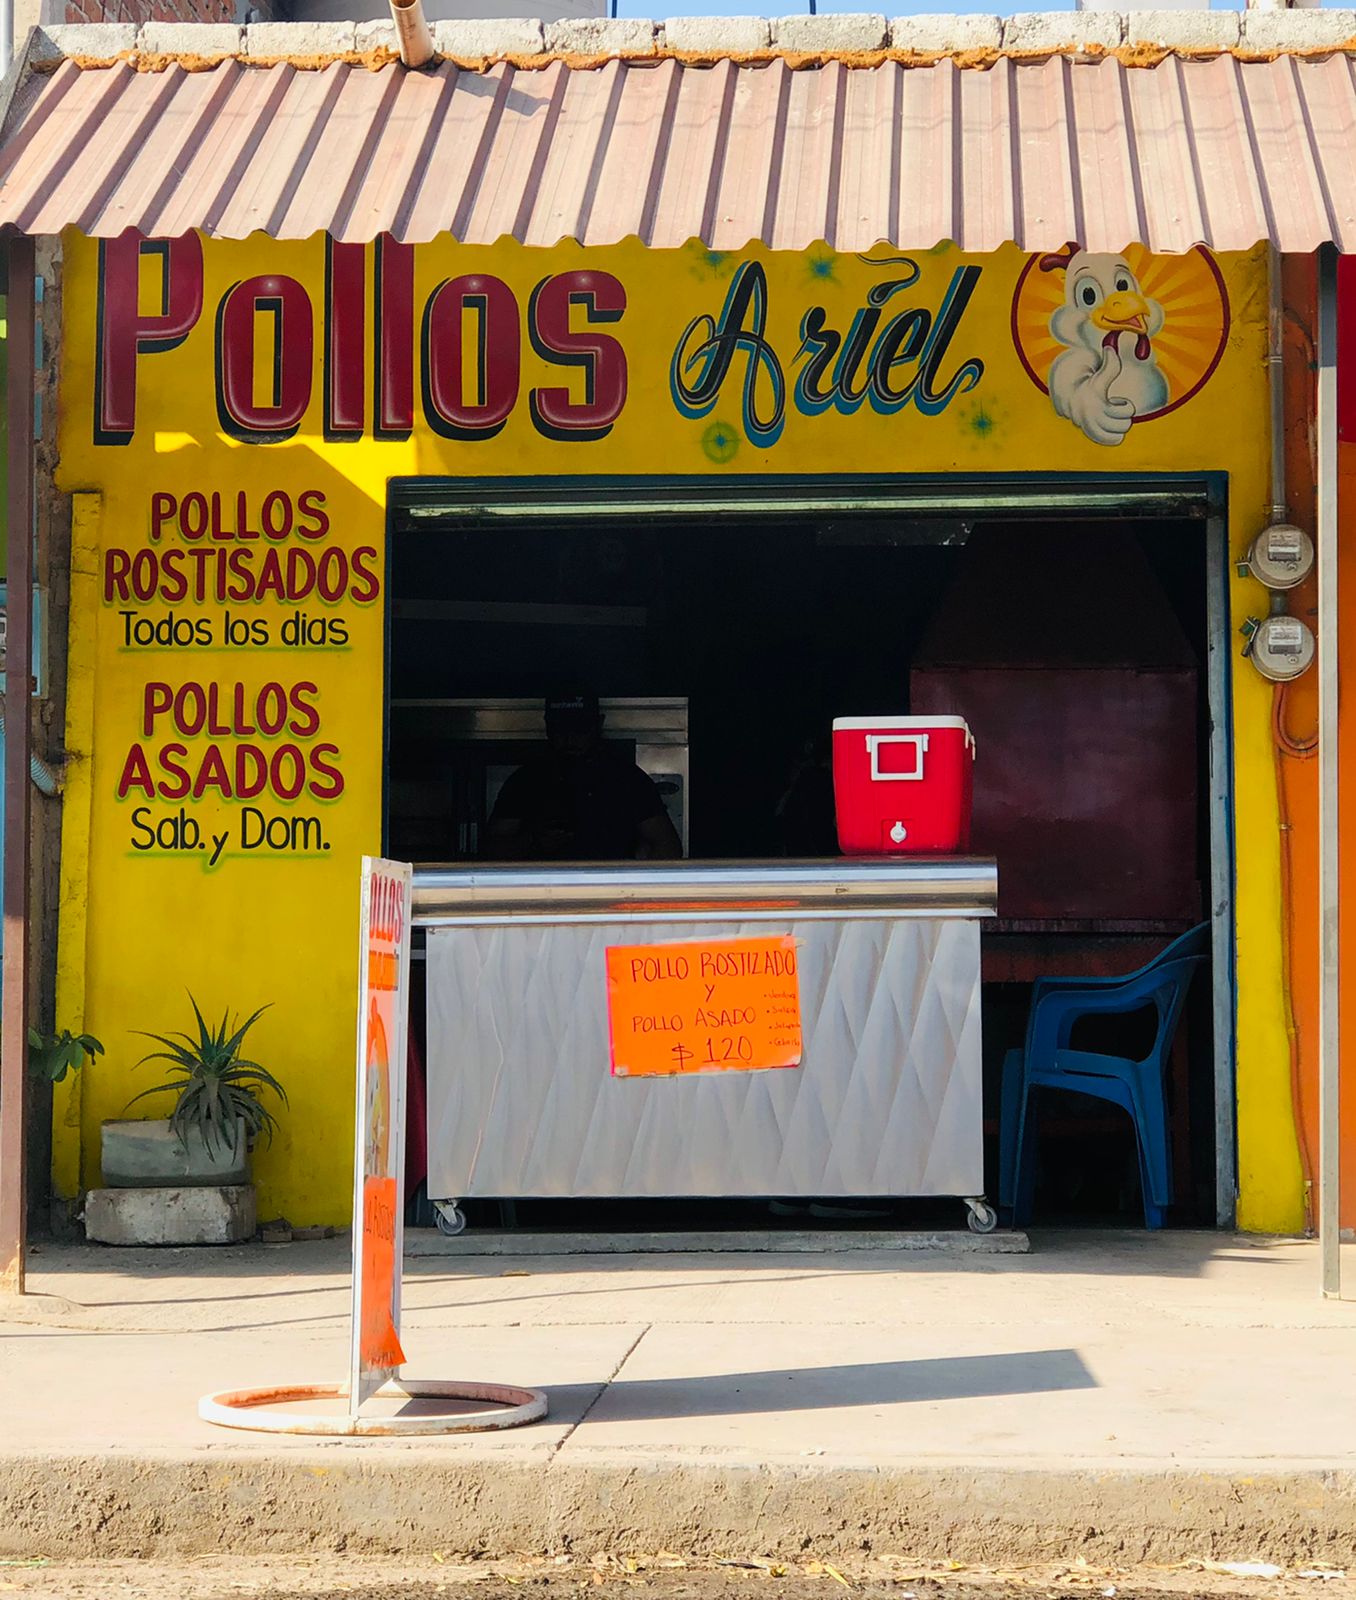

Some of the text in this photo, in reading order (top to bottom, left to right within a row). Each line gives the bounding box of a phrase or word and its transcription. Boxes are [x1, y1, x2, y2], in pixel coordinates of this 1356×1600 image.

[93, 230, 985, 448] Pollos Ariel
[150, 489, 330, 541] POLLOS
[104, 546, 381, 602] ROSTISADOS
[118, 610, 349, 646] Todos los dias
[143, 681, 321, 737] POLLOS
[117, 742, 345, 800] ASADOS
[240, 806, 331, 850] Dom.
[630, 950, 796, 983] POLLO ROSTIZADO
[632, 1006, 756, 1033] POLLO ASADO
[702, 1036, 753, 1064] 120
